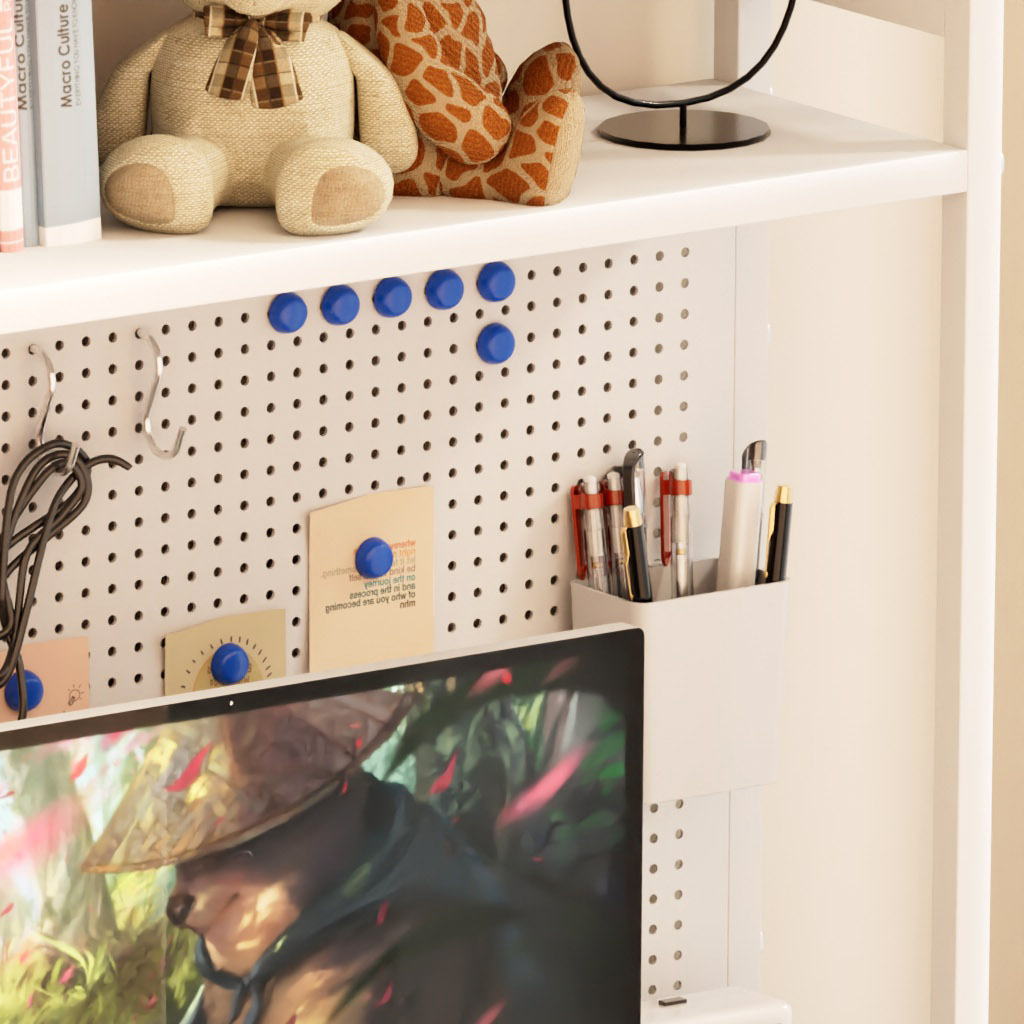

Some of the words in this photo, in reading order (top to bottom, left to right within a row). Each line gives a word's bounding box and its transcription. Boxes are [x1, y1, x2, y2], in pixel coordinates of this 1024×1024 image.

[57, 4, 71, 56] Culture
[17, 53, 28, 111] Macro
[60, 61, 73, 108] Macro
